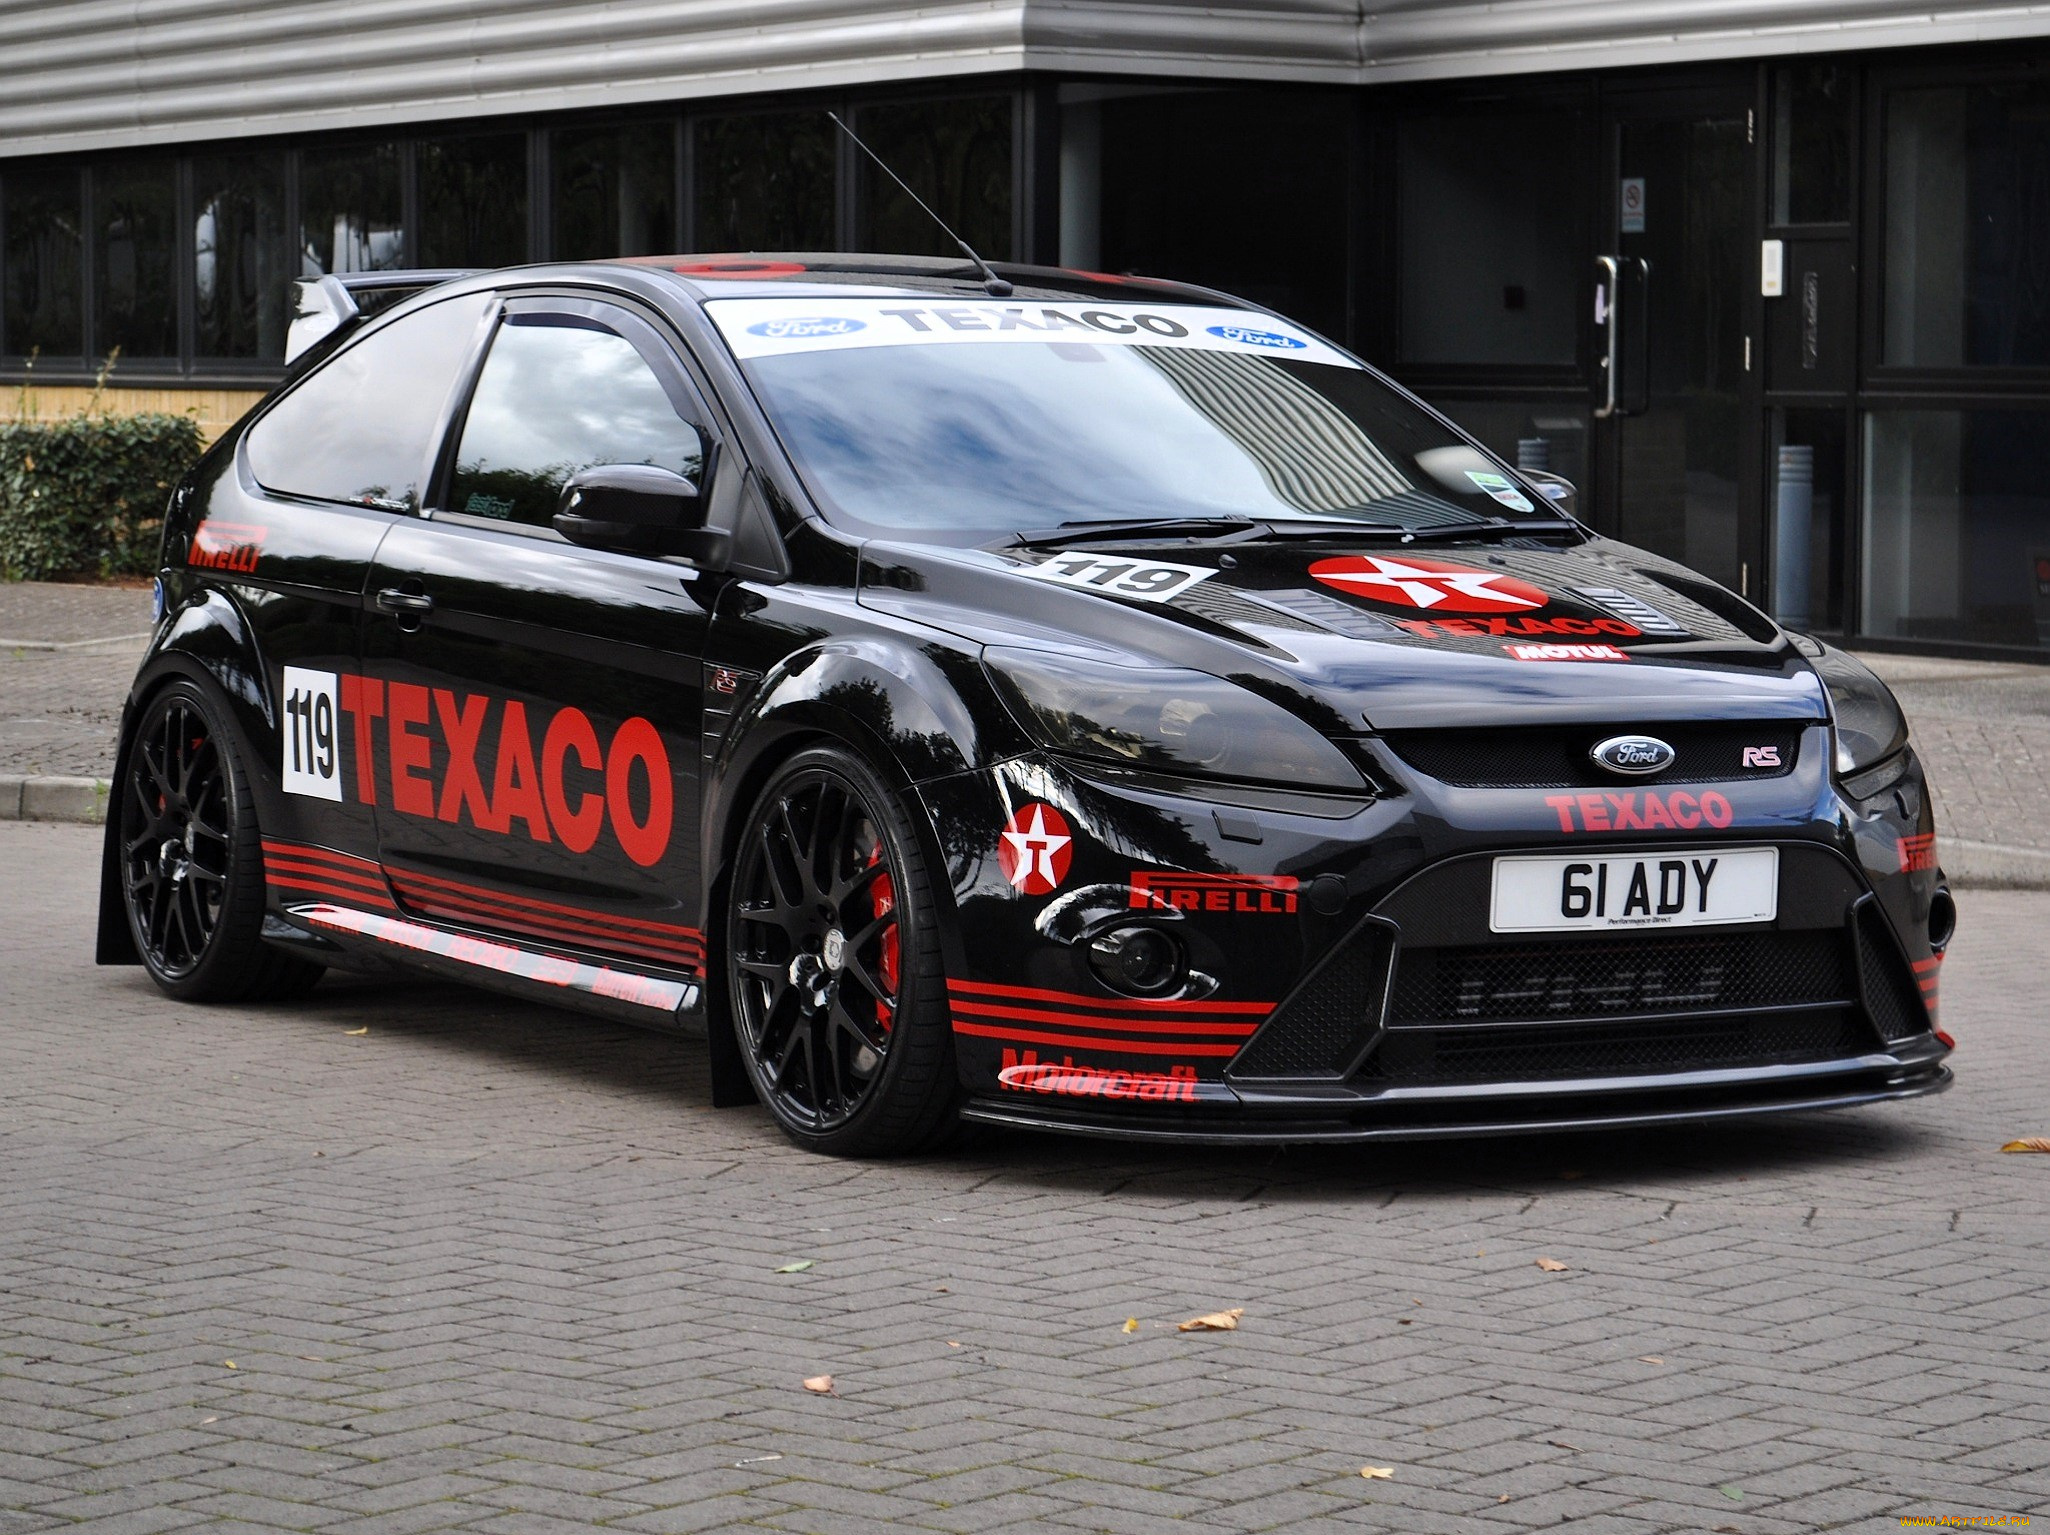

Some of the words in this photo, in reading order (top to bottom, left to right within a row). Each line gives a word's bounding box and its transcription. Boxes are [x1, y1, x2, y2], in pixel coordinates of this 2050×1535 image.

[765, 318, 849, 337] Ford
[879, 308, 1189, 338] TEXACO
[1222, 326, 1296, 348] Ford
[1055, 559, 1191, 593] 119
[1394, 617, 1643, 639] TEXACO
[1510, 644, 1624, 660] MOTUL
[286, 687, 334, 779] 119
[1616, 742, 1659, 764] Ford
[1742, 746, 1782, 768] RS
[341, 673, 673, 867] TEXACO
[1544, 790, 1734, 833] TEXACO
[1129, 871, 1299, 914] PIRELLI
[1623, 859, 1719, 917] ADY
[1001, 1047, 1199, 1103] Motorcraft
